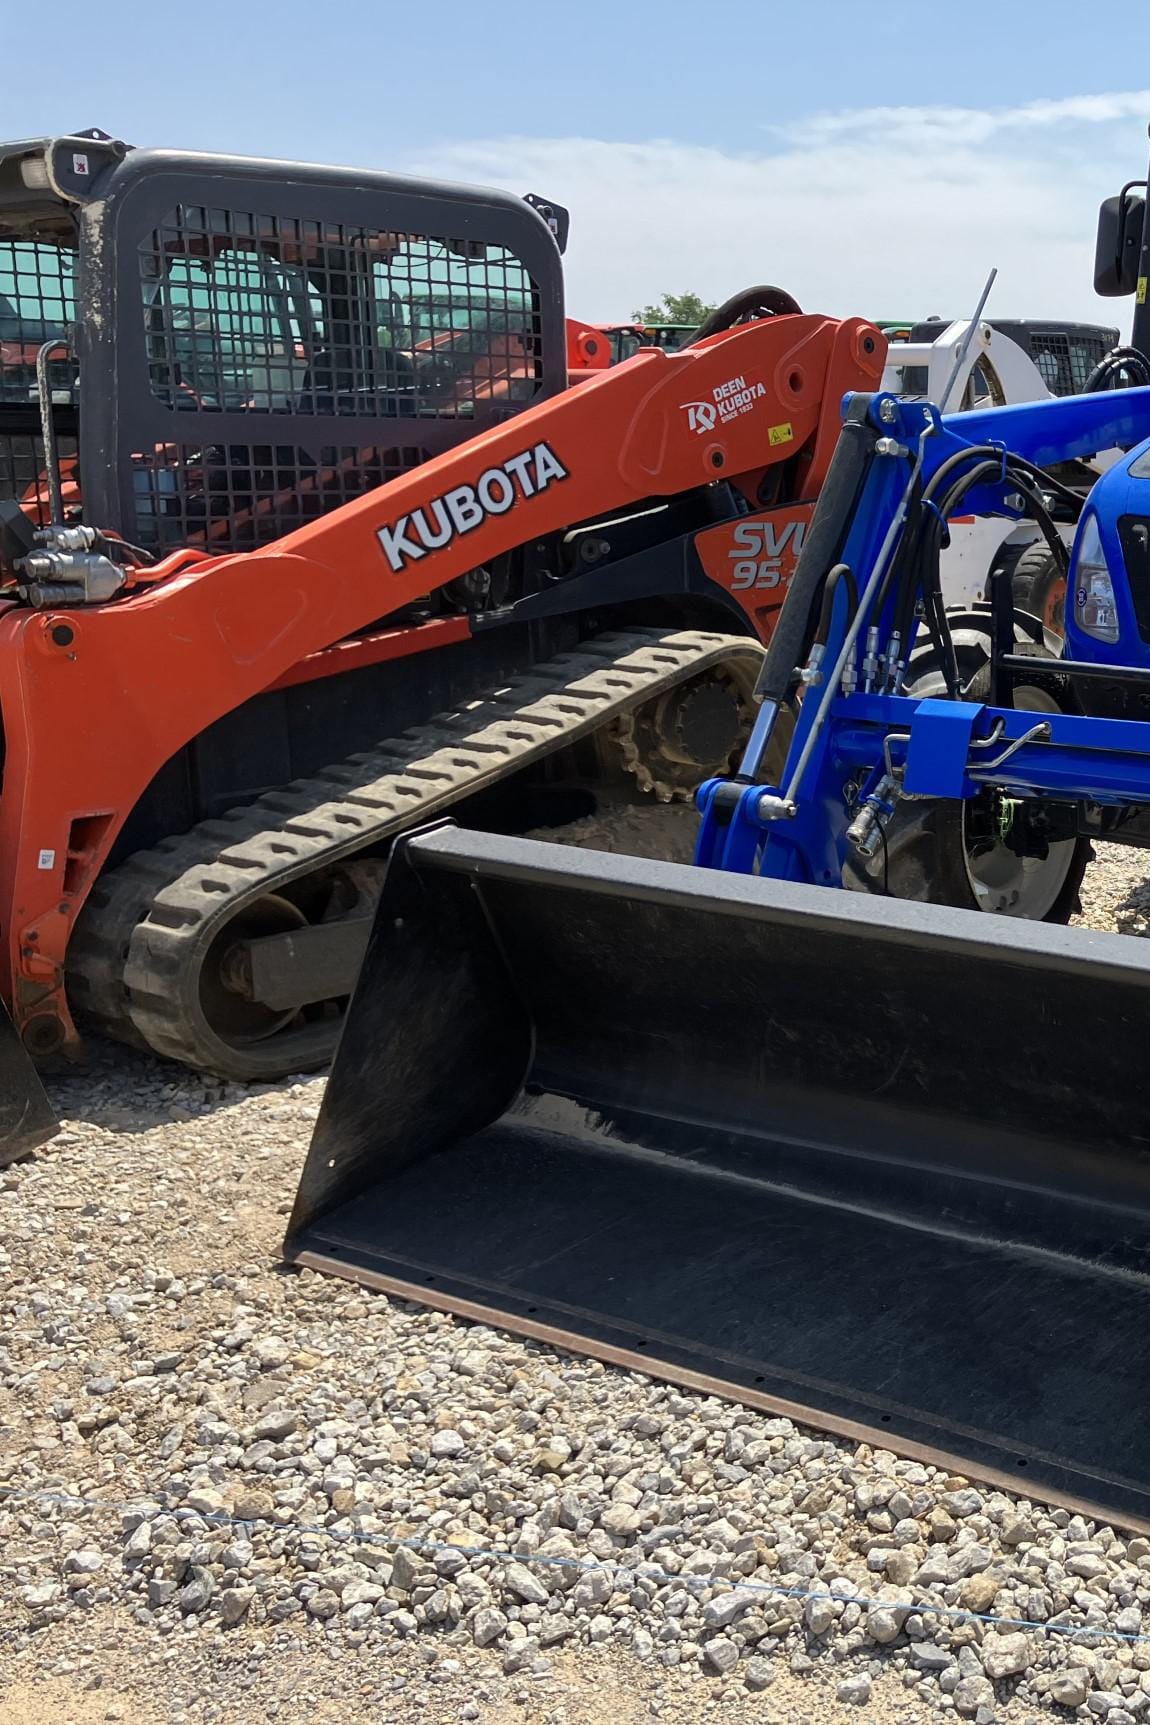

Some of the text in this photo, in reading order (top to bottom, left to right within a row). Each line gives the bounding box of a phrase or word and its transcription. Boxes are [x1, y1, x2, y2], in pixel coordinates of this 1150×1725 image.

[713, 375, 747, 402] DEEN
[716, 382, 767, 416] KUBOTA
[720, 411, 739, 424] SINCE
[376, 441, 569, 572] KUBOTA
